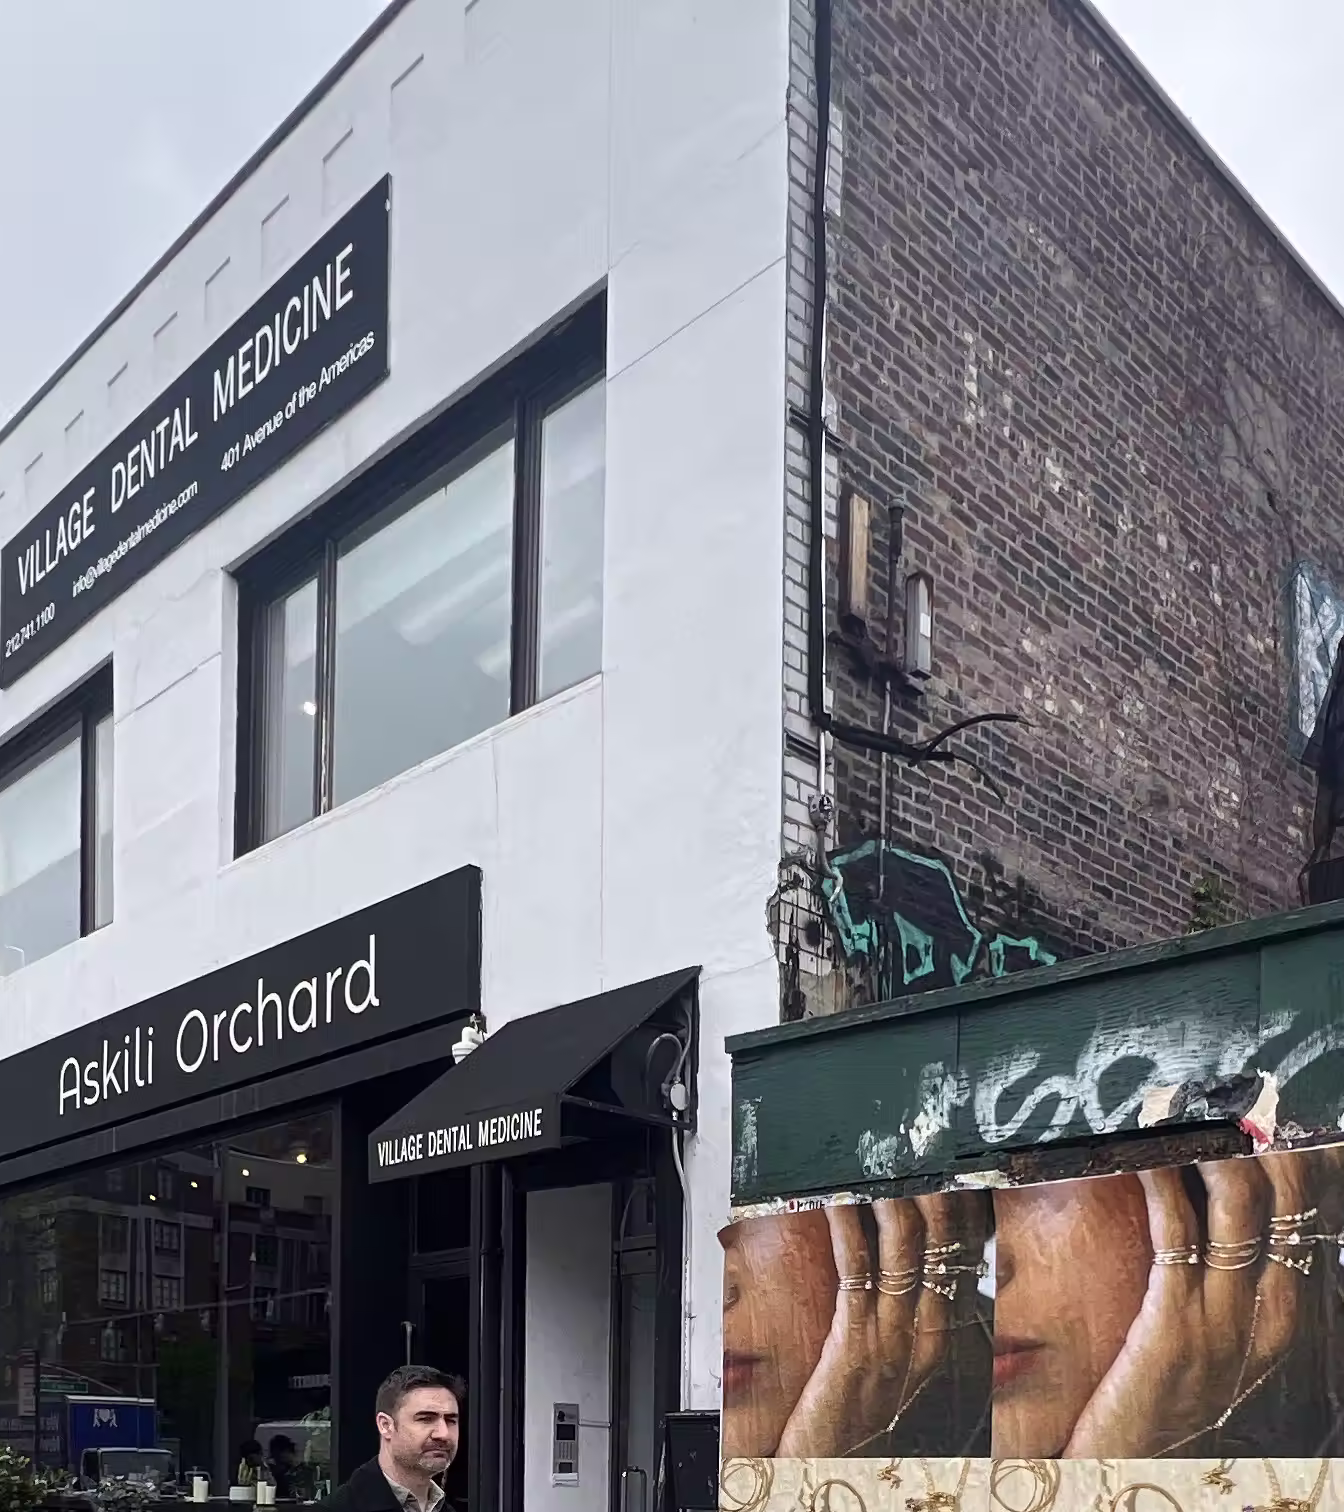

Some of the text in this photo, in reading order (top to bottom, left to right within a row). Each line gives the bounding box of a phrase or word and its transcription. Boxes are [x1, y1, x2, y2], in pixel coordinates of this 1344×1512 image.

[17, 243, 354, 595] VILLAGE DENTAL MEDICINE
[220, 330, 376, 472] 401 Avenue of the Americas
[5, 479, 198, 659] 212.741.1100 info@villagedentalmedicine.com
[59, 934, 380, 1116] Askili Orchard
[378, 1108, 543, 1167] VILLAGE DENTAL MEDICINE
